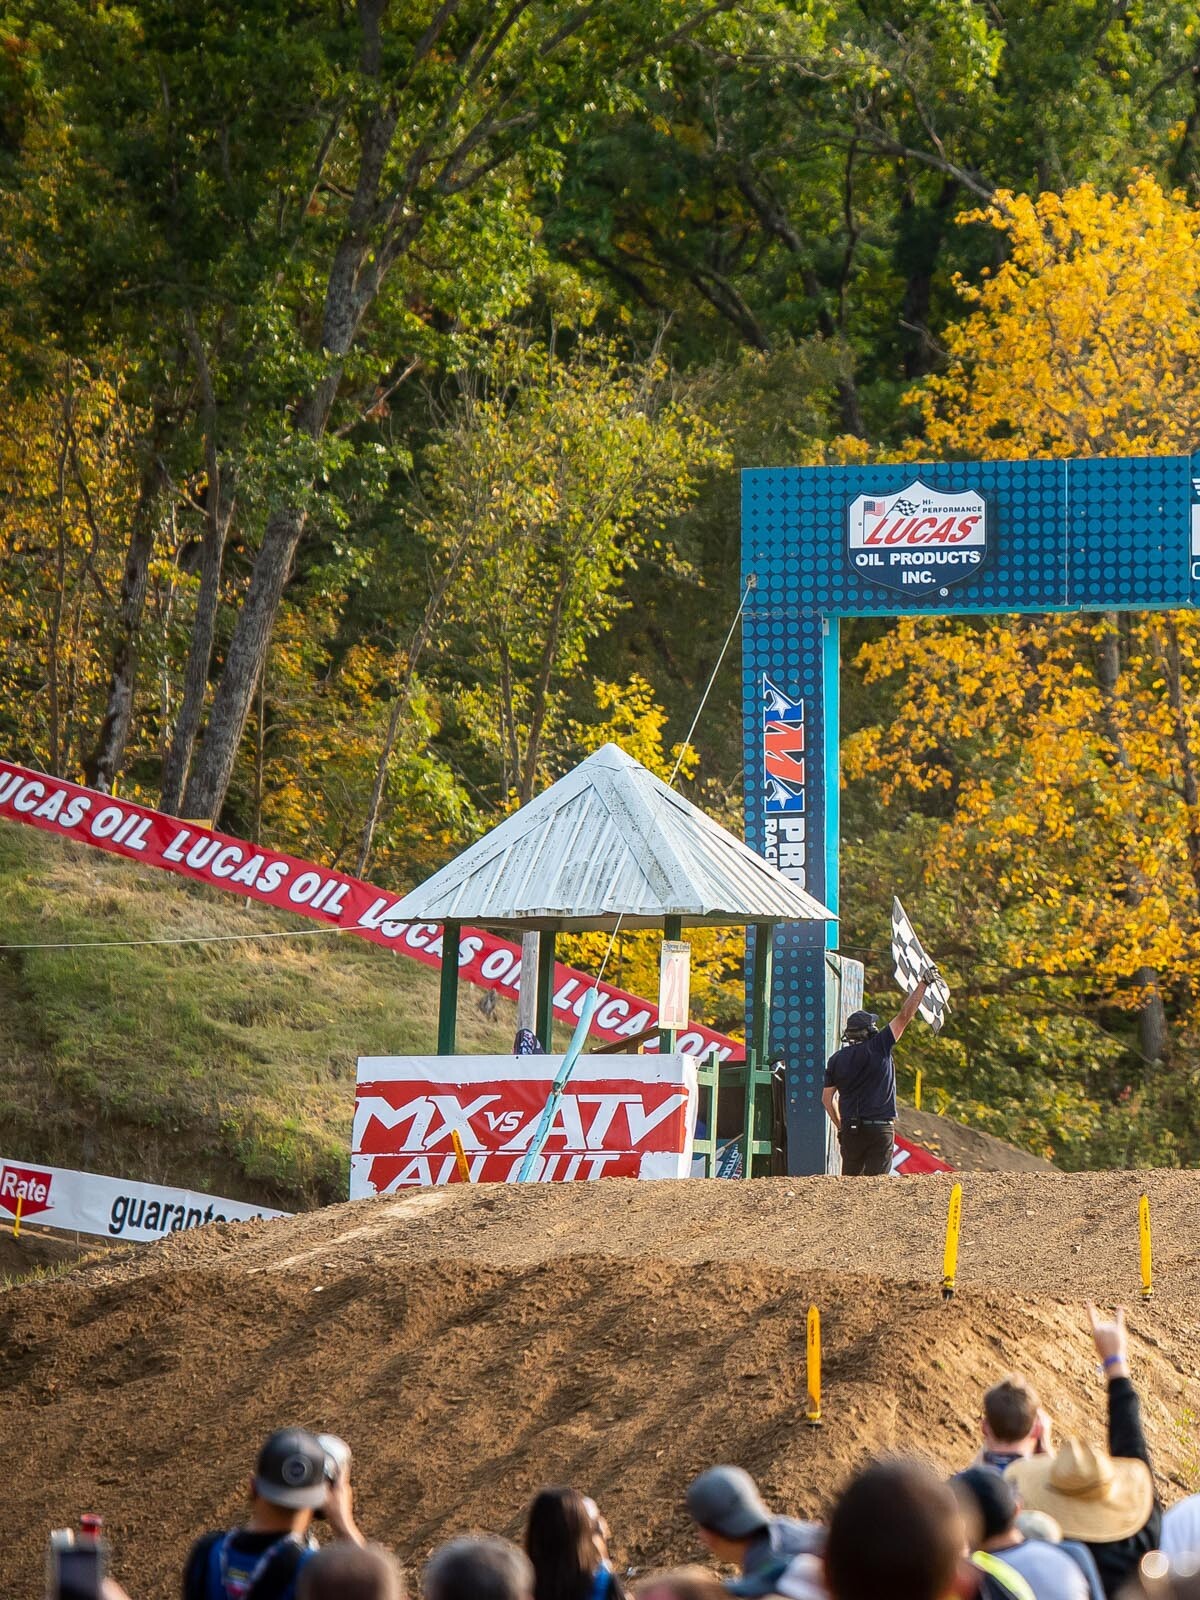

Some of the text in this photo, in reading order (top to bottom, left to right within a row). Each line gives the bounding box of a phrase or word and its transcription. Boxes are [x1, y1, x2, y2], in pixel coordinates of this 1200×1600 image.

[922, 506, 982, 514] PERFORMANCE
[864, 515, 980, 545] LUCAS
[855, 550, 981, 567] OIL PRODUCTS
[902, 571, 936, 584] INC.
[764, 818, 779, 872] RACI
[779, 818, 806, 890] PRO
[0, 772, 91, 828] UCAS
[90, 806, 153, 850] OIL
[162, 829, 290, 893] LUCAS
[288, 871, 351, 916] OIL
[481, 949, 522, 990] OI
[553, 978, 659, 1048] LCA
[353, 1095, 501, 1151] MX
[500, 1094, 688, 1150] ATV
[1, 1172, 47, 1202] Rate
[108, 1195, 262, 1234] guarant
